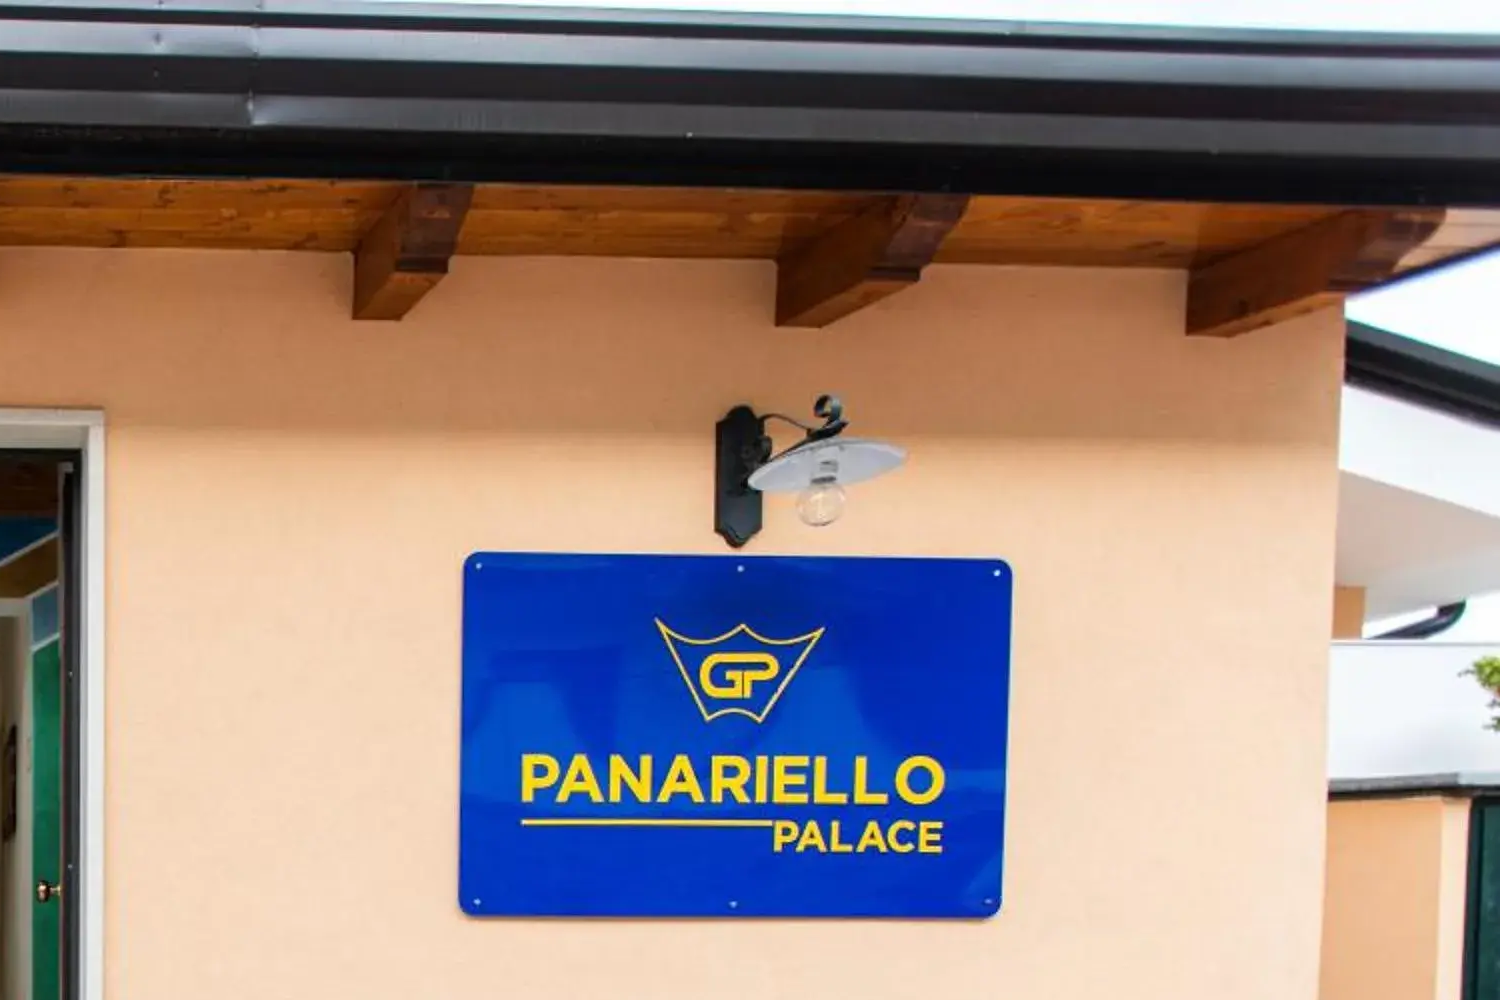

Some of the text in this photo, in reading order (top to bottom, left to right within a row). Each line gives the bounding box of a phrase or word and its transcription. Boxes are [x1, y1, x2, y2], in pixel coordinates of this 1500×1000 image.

[699, 652, 779, 698] GP
[520, 753, 946, 805] PANARIELLO
[772, 820, 944, 853] PALACE
